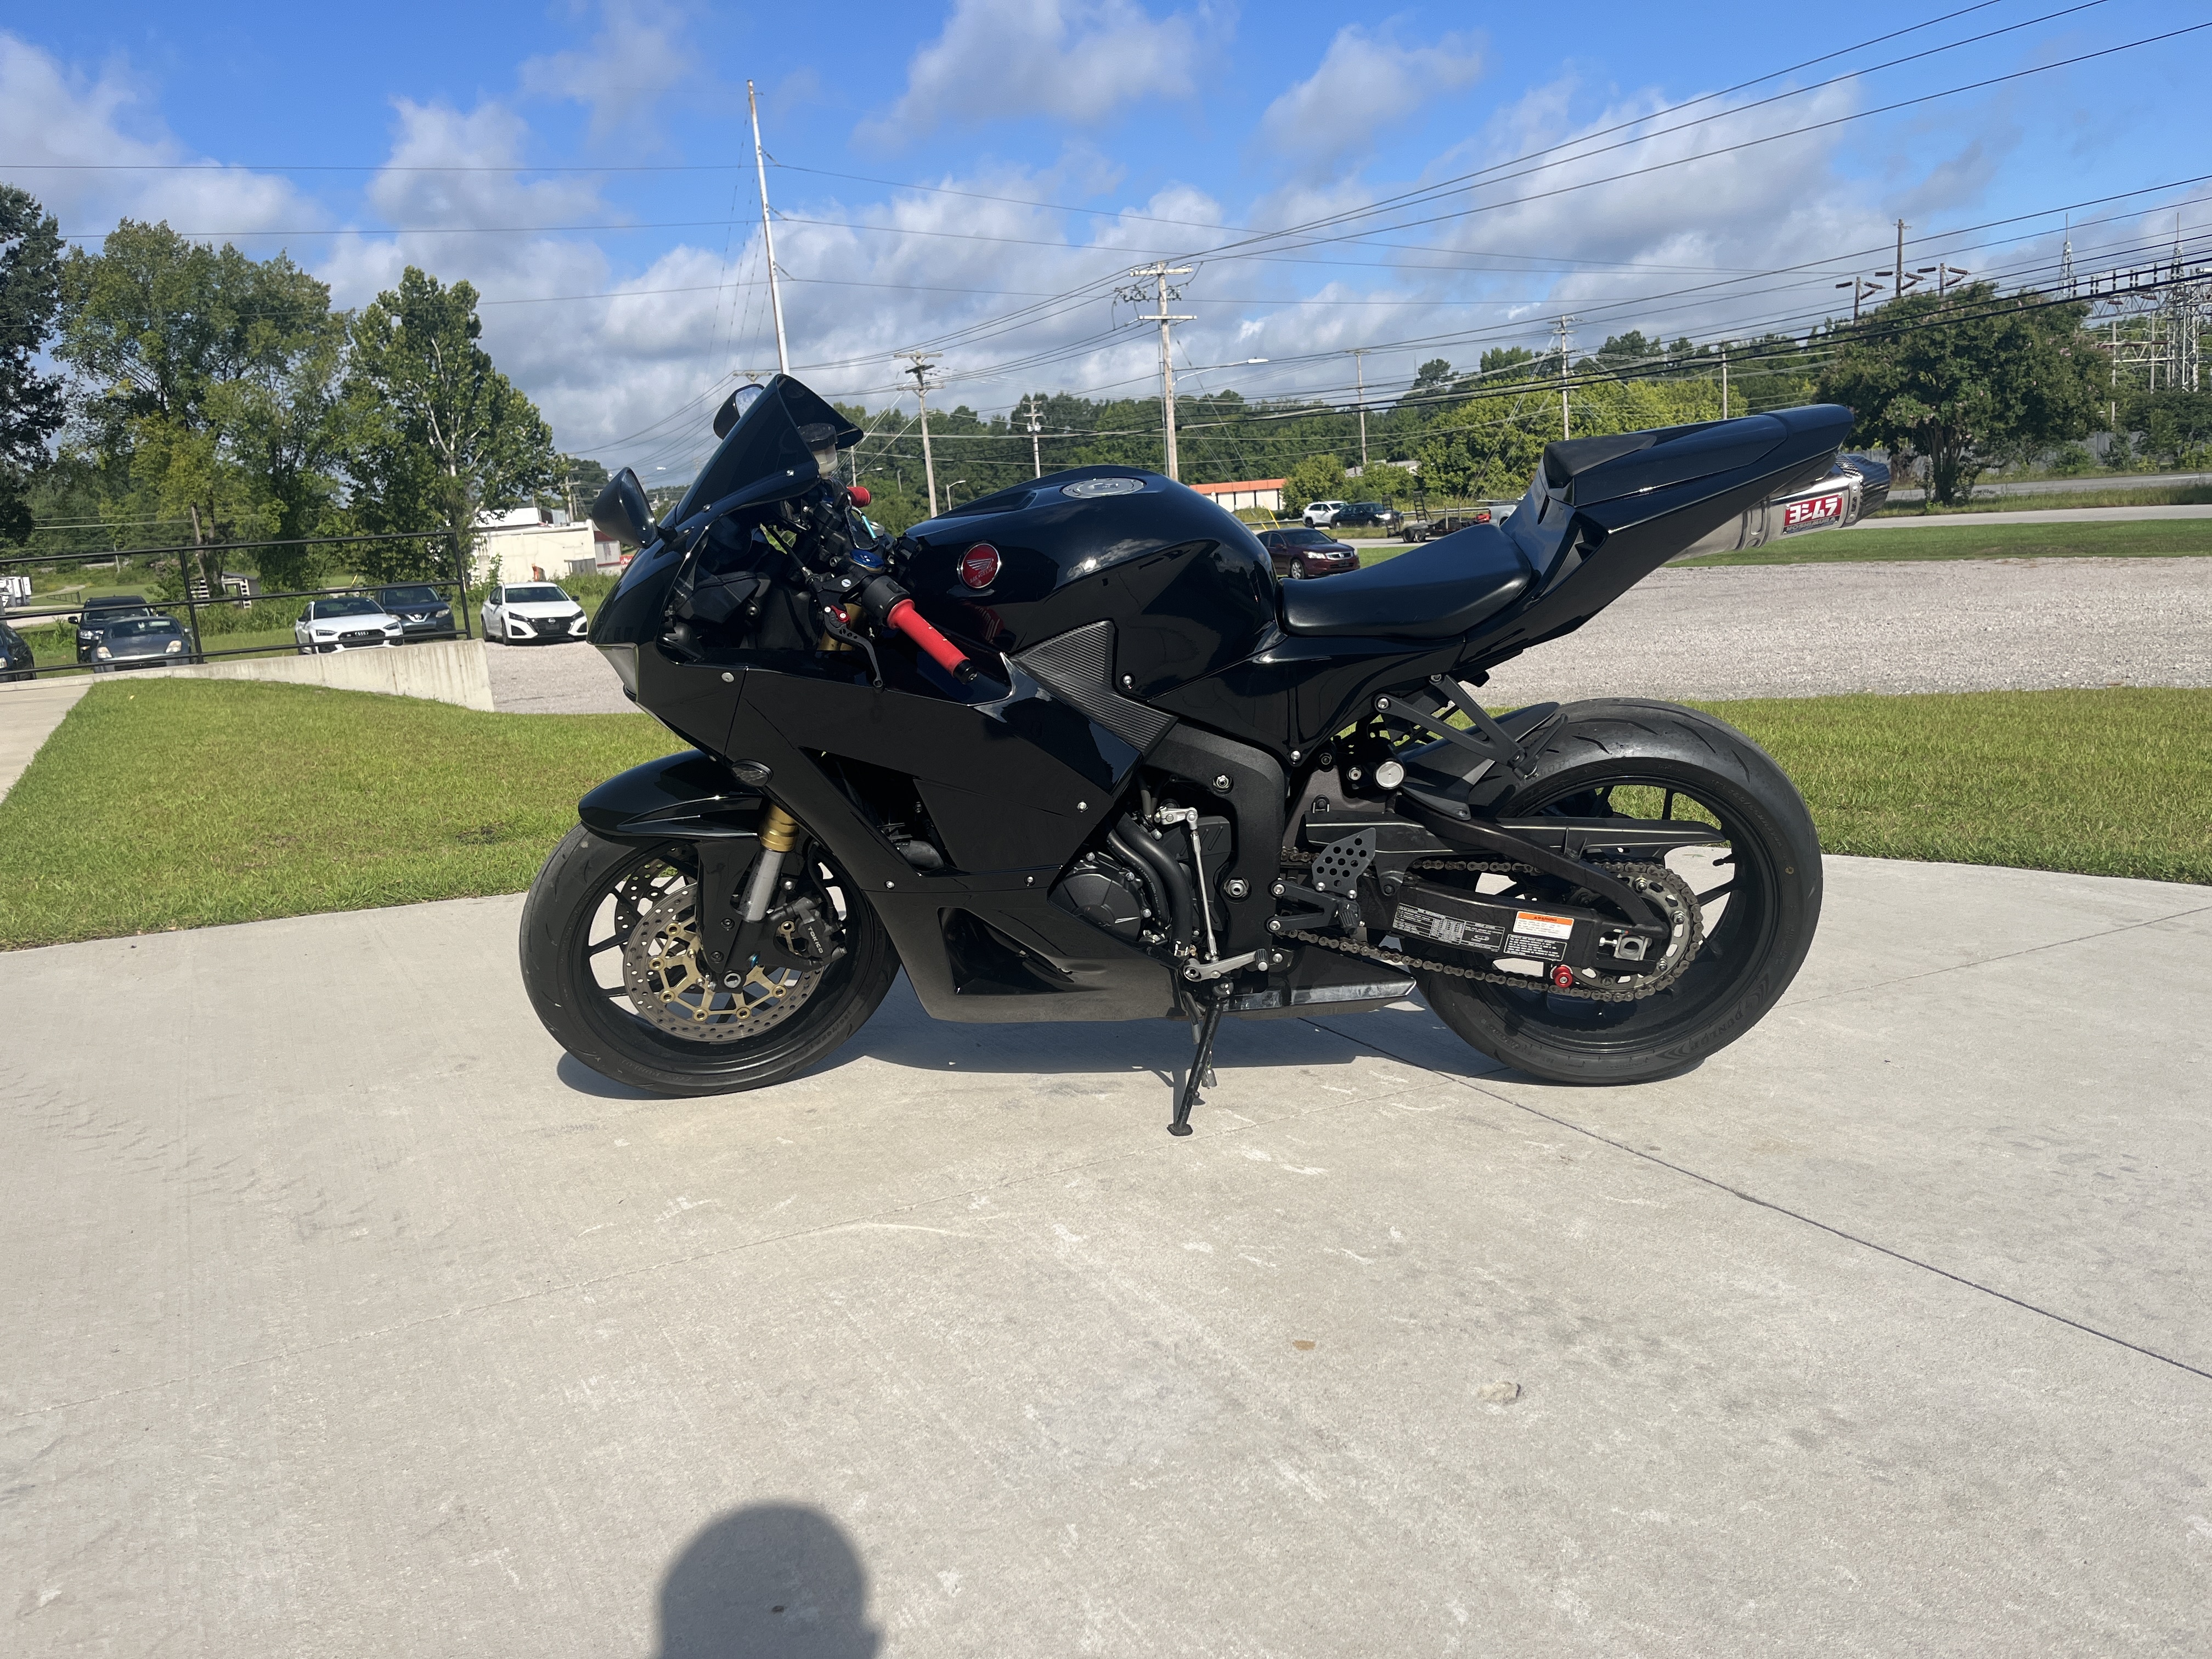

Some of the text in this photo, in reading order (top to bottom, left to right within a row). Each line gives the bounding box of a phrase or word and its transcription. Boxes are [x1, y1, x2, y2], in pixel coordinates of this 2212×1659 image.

[1789, 497, 1838, 523] ヨシムラ
[808, 926, 823, 953] TOKICO
[1690, 1001, 1743, 1051] DUNLOP
